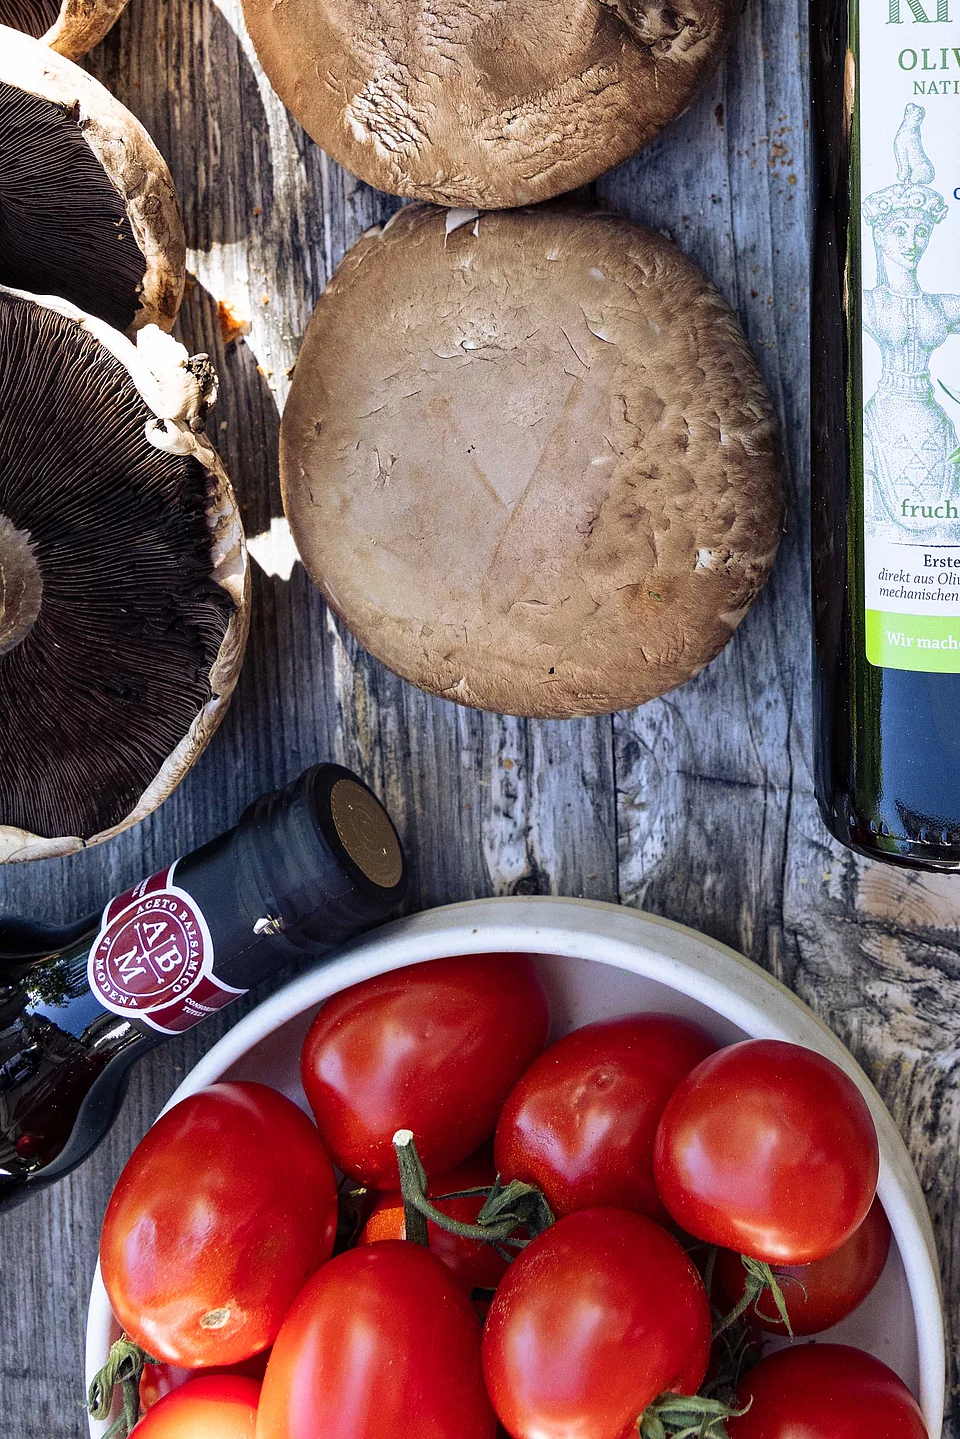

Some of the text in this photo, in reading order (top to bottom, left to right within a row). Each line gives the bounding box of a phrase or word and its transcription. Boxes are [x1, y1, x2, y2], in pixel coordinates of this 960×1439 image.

[923, 554, 960, 568] Erste
[878, 568, 911, 584] direkt
[913, 574, 934, 584] aus
[879, 586, 959, 602] mechanischen
[886, 631, 914, 648] Wir
[137, 898, 178, 915] ACETO
[172, 910, 200, 993] BALSAMICO
[143, 921, 183, 973] A B
[114, 945, 147, 985] M
[95, 958, 138, 1006] MODENA
